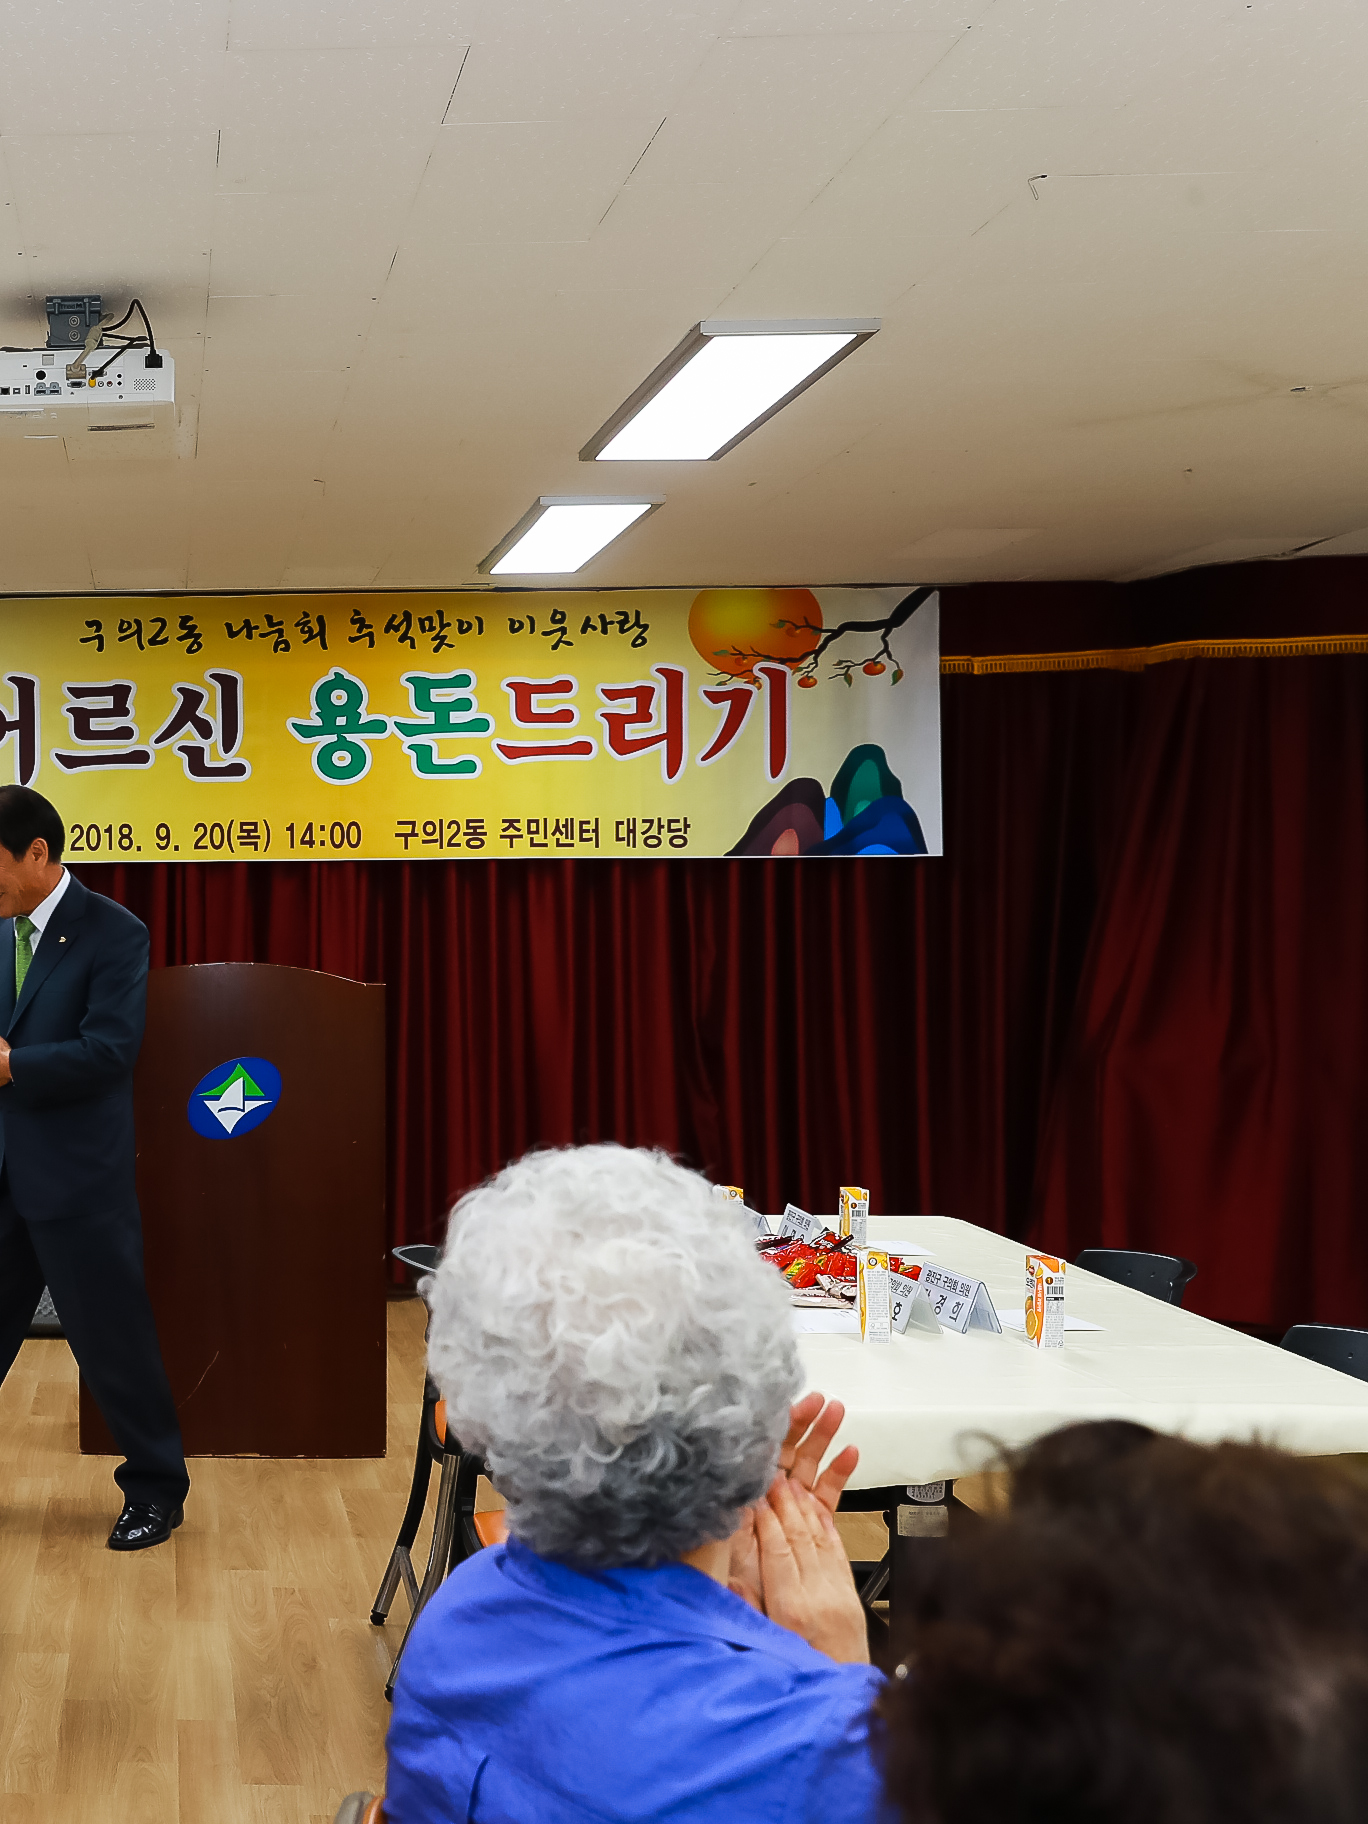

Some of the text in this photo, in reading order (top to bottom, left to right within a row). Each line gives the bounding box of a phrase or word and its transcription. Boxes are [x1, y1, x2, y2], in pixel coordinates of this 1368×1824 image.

[78, 614, 204, 655] 구의2동
[347, 608, 485, 654] 추석맞이
[507, 608, 650, 650] 이웃사랑
[70, 816, 692, 853] 2018. 9. 20(목) 14:00 구의2동 주민센터 대강당
